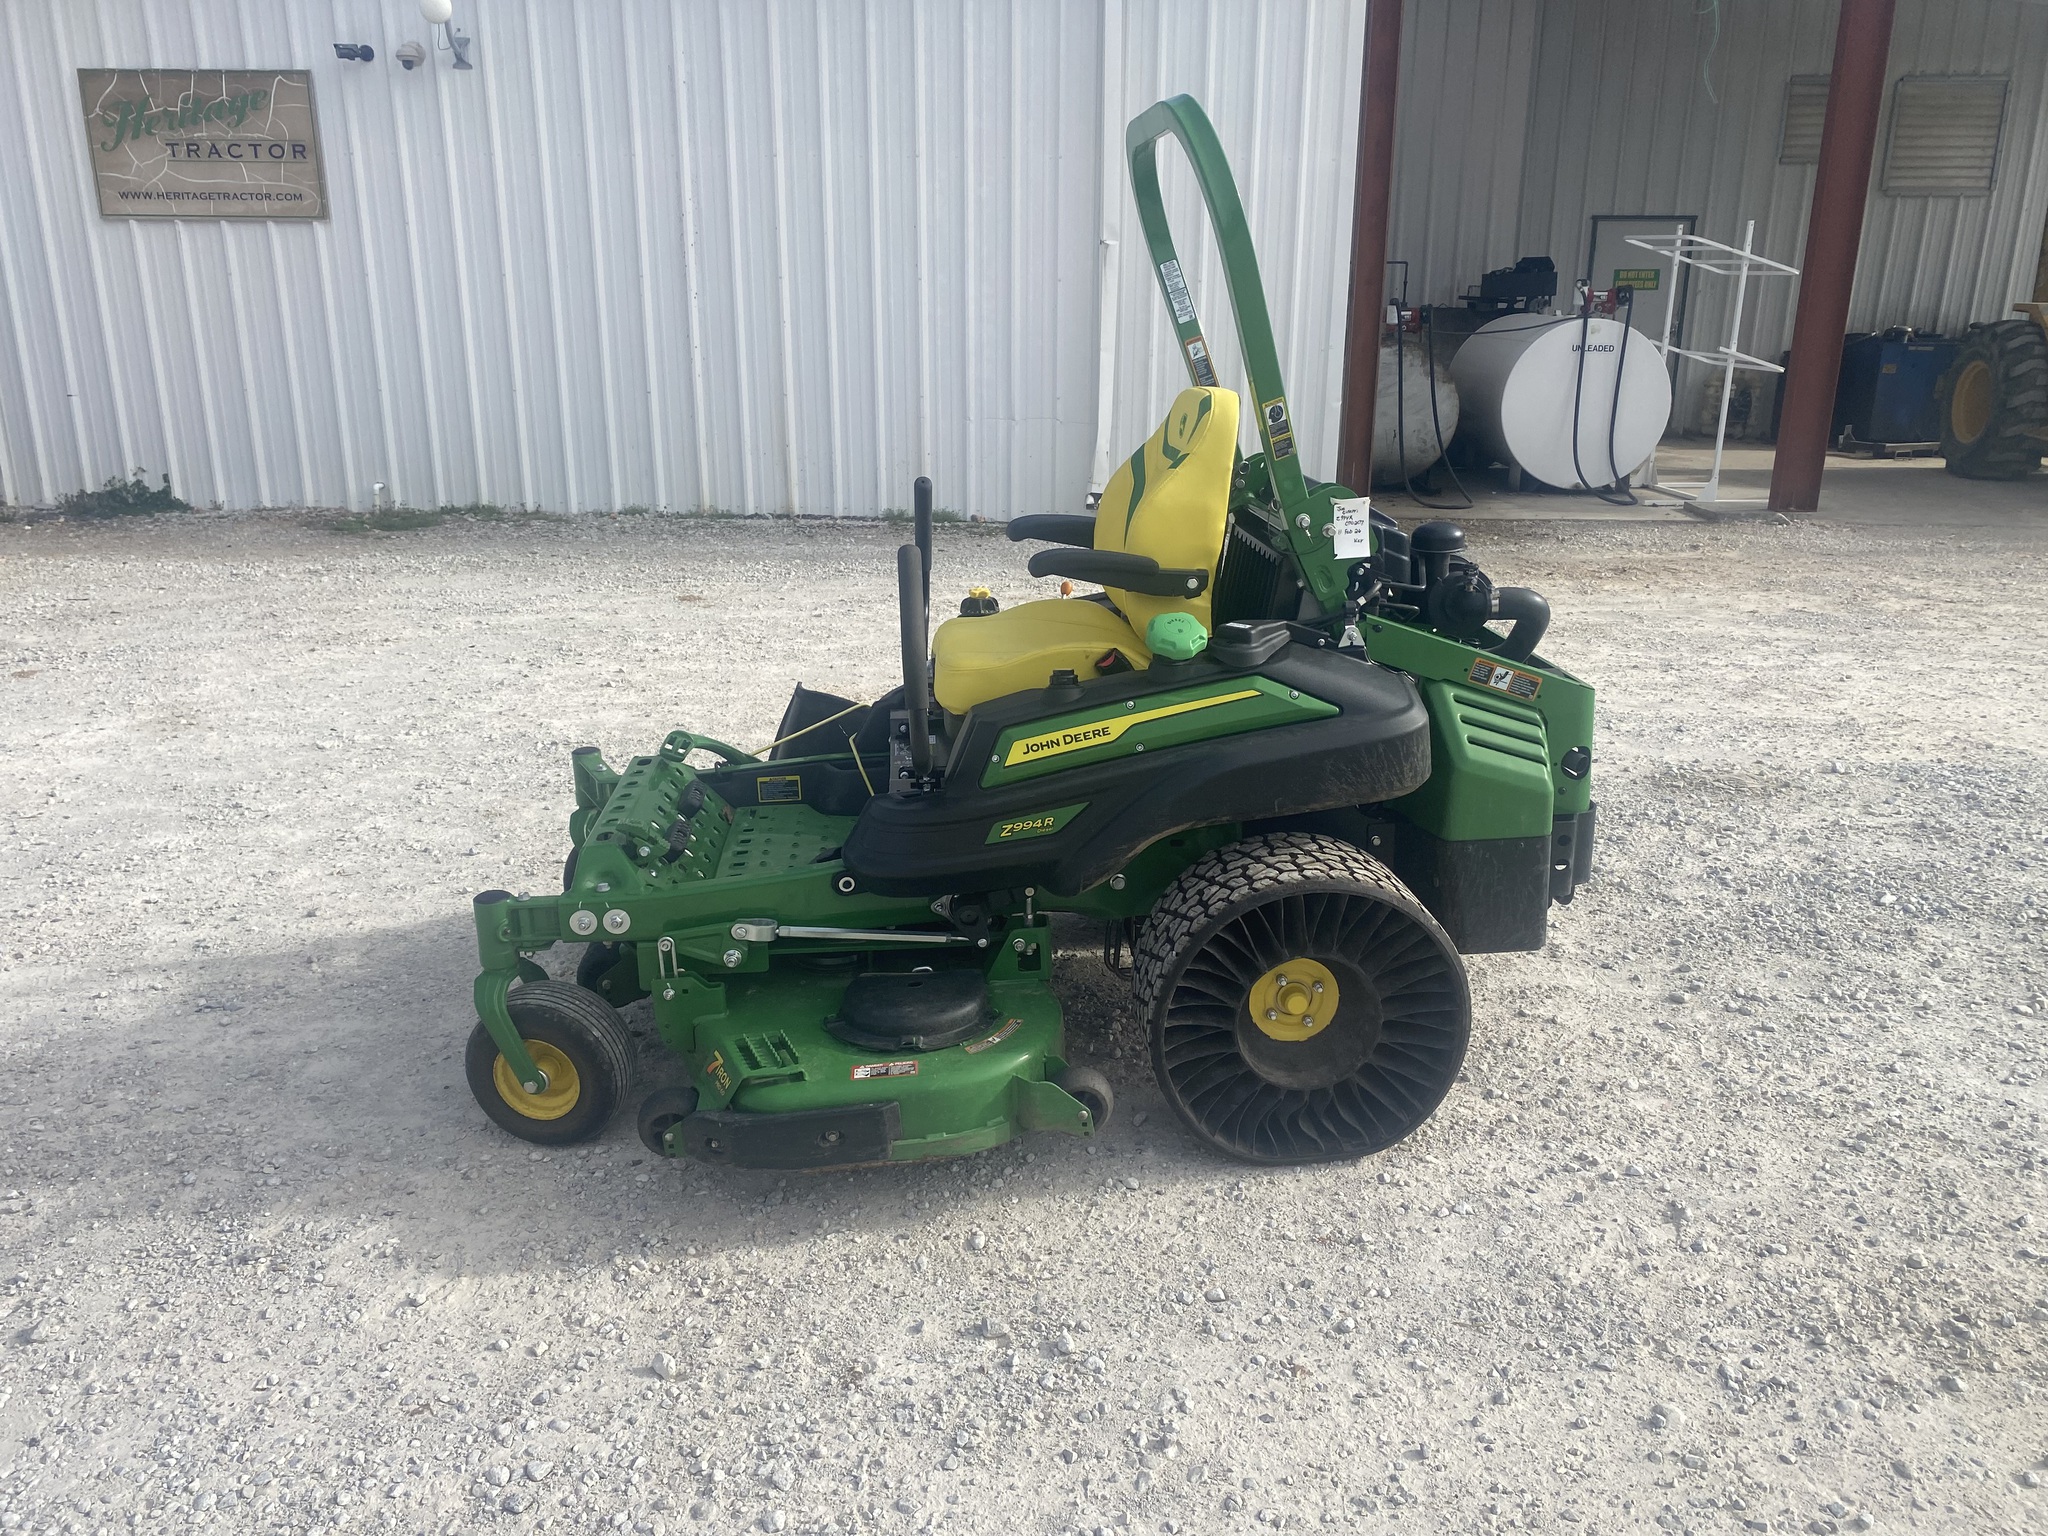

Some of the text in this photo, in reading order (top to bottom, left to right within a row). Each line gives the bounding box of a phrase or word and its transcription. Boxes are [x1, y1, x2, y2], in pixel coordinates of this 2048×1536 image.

[101, 89, 267, 152] Heritage
[165, 142, 307, 160] TRACTOR
[118, 190, 303, 202] WWW.HERITAGETRACTOR.COM
[1023, 727, 1111, 755] JOHN DEERE
[1000, 817, 1054, 837] Z994R
